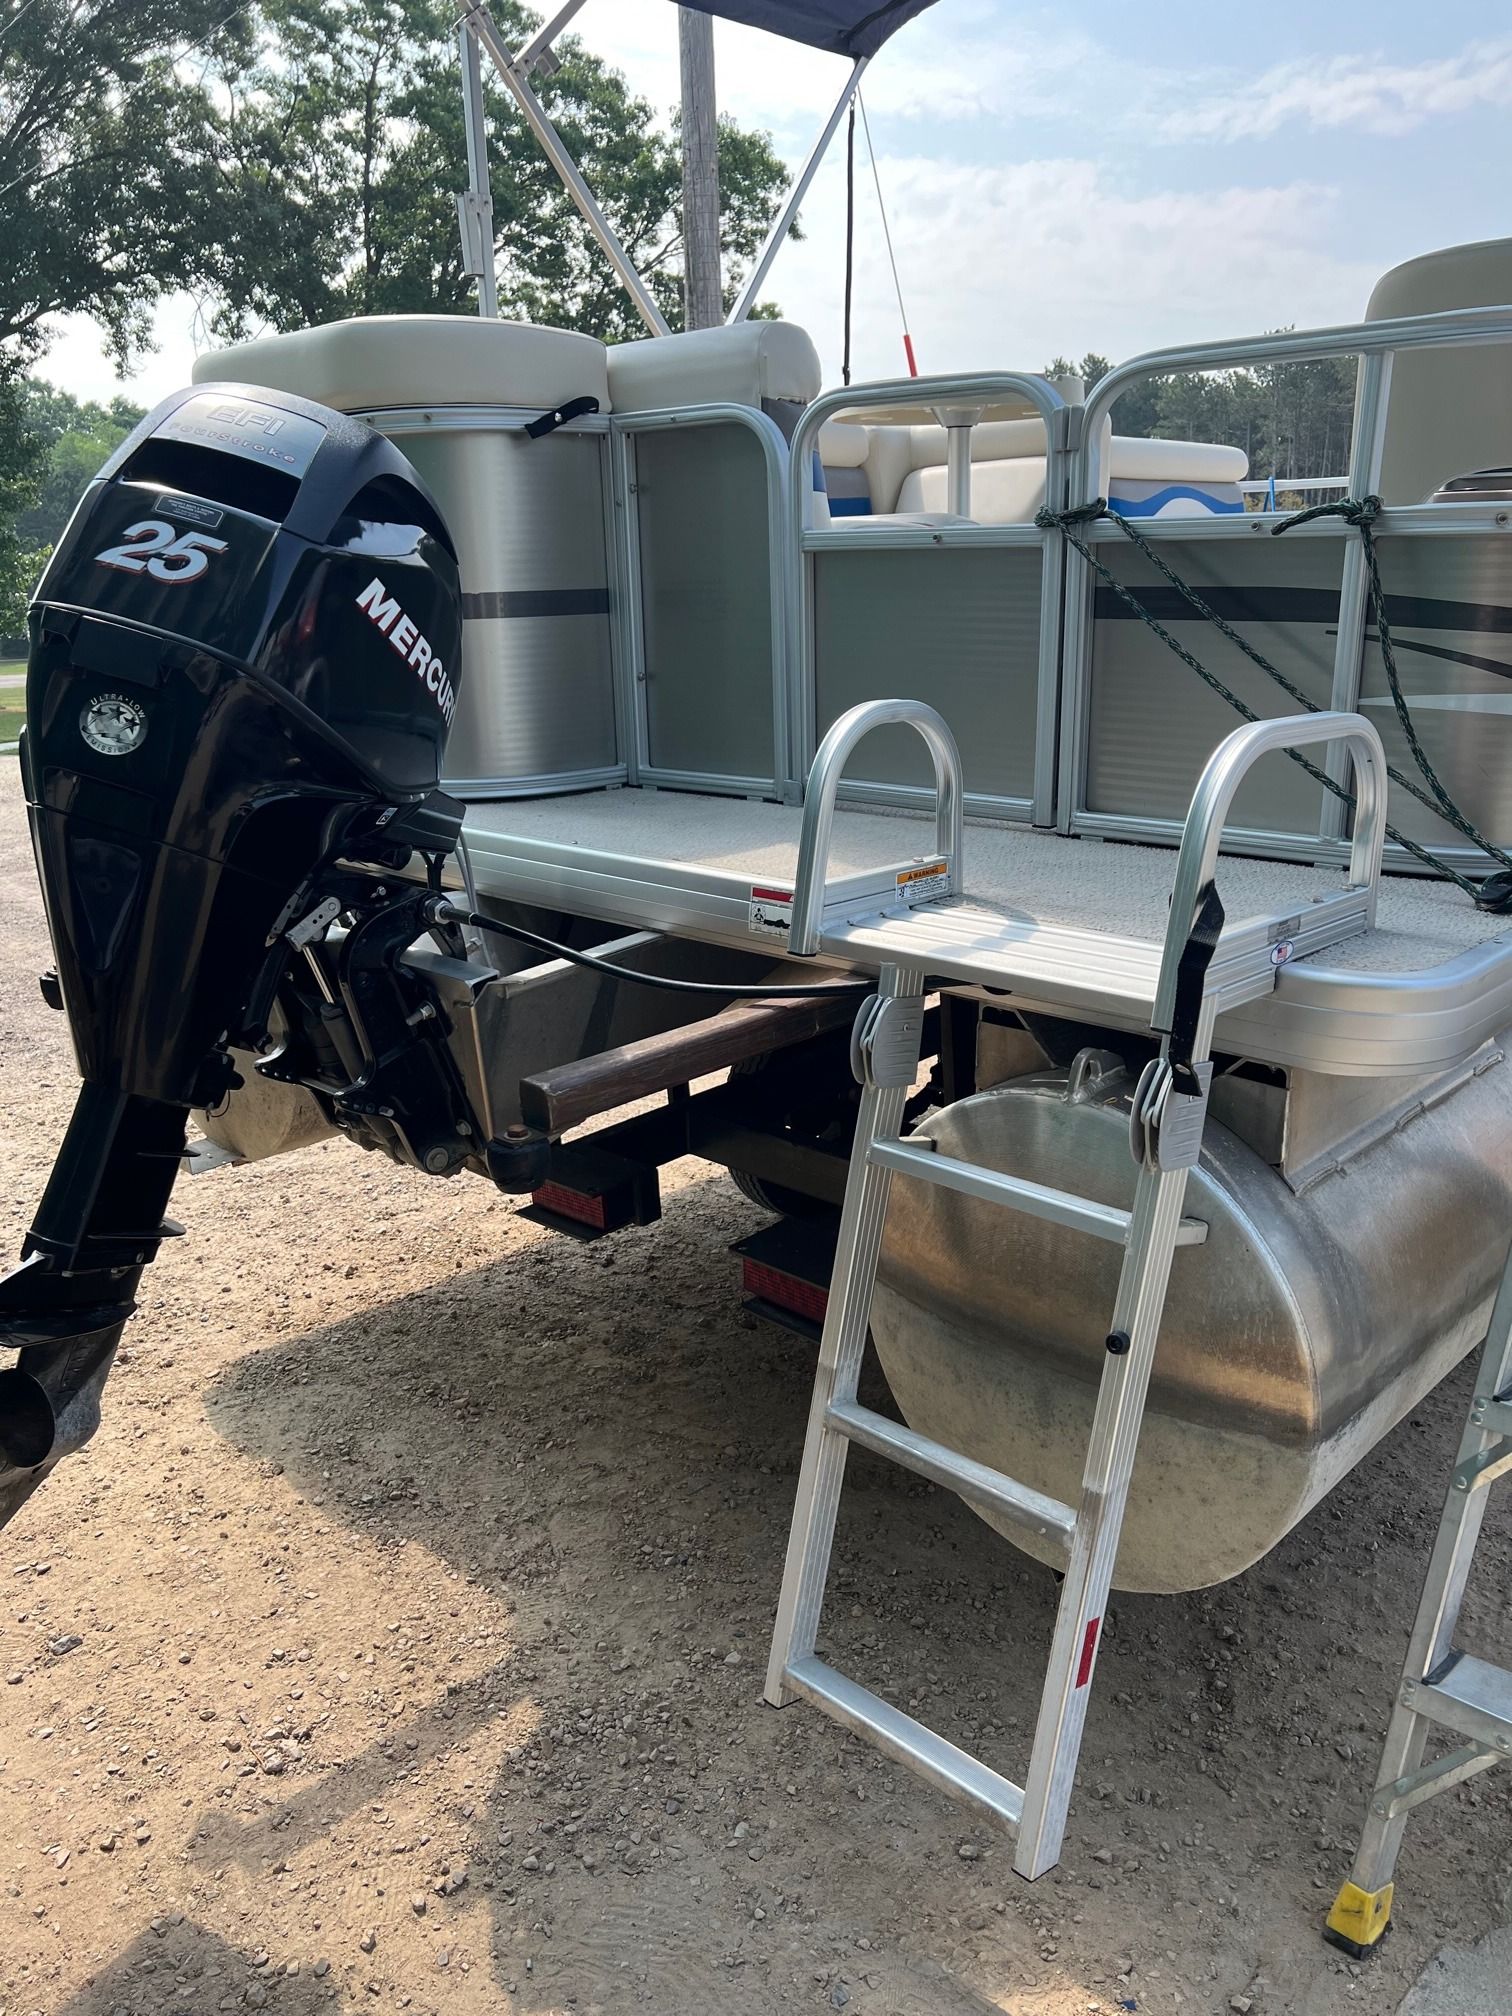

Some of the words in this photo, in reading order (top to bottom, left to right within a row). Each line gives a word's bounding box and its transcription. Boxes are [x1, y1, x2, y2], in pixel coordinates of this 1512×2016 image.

[206, 405, 287, 437] EFI
[169, 422, 297, 464] FourStroke
[95, 520, 228, 584] 25
